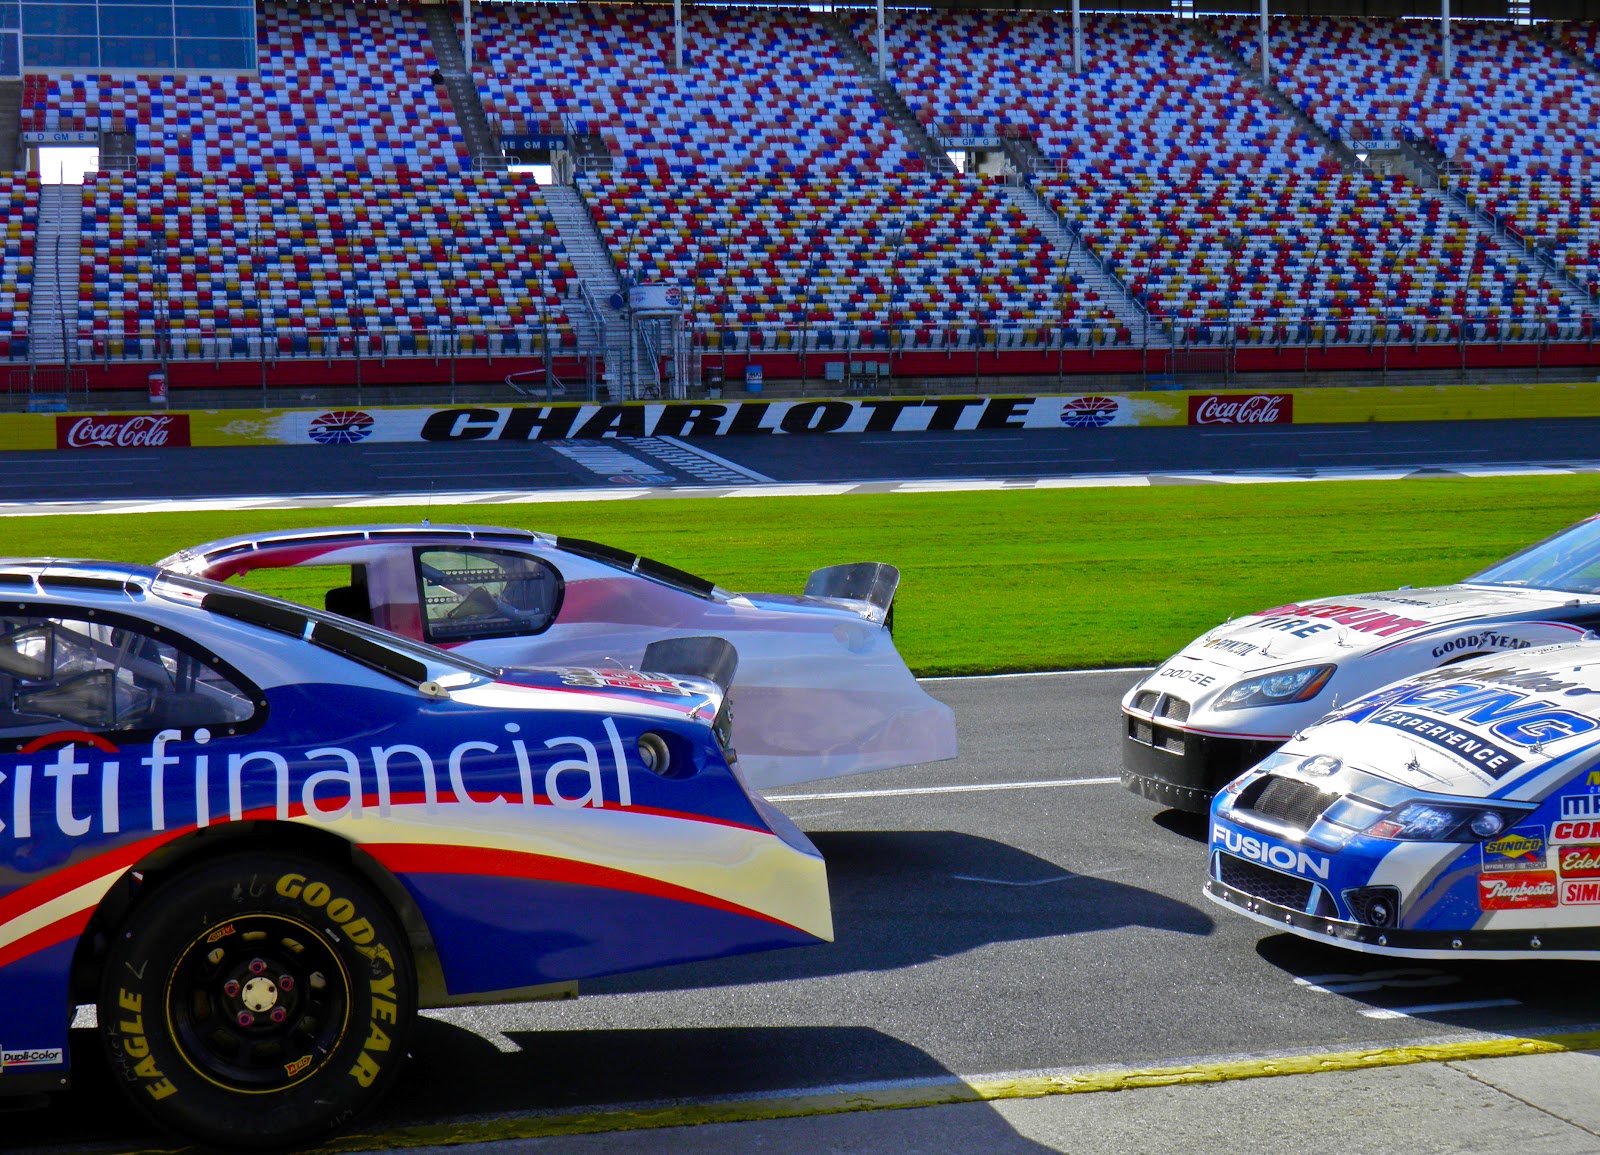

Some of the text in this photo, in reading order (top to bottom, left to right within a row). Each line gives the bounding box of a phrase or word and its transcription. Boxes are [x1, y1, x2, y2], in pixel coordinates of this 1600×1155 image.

[37, 133, 85, 141] D GM E
[509, 141, 555, 149] E GM F
[962, 138, 976, 146] GM
[982, 138, 989, 146] G
[1365, 141, 1378, 149] GM
[420, 396, 1036, 442] CHARLOTTE
[1196, 395, 1285, 425] Coca-Cola
[67, 416, 174, 448] Coca-Cola
[1246, 616, 1333, 639] TIRE
[1160, 668, 1216, 687] DODGE
[1380, 711, 1509, 769] EXPERIENCE
[0, 716, 632, 840] itifinancial
[1212, 823, 1330, 880] FUSION
[1487, 839, 1540, 852] SUNOCO
[1480, 880, 1556, 902] Raybestos
[1566, 883, 1600, 902] SIM
[119, 987, 178, 1101] EAGLE
[4, 1050, 59, 1062] Dupli-Color
[289, 1057, 310, 1074] AERO
